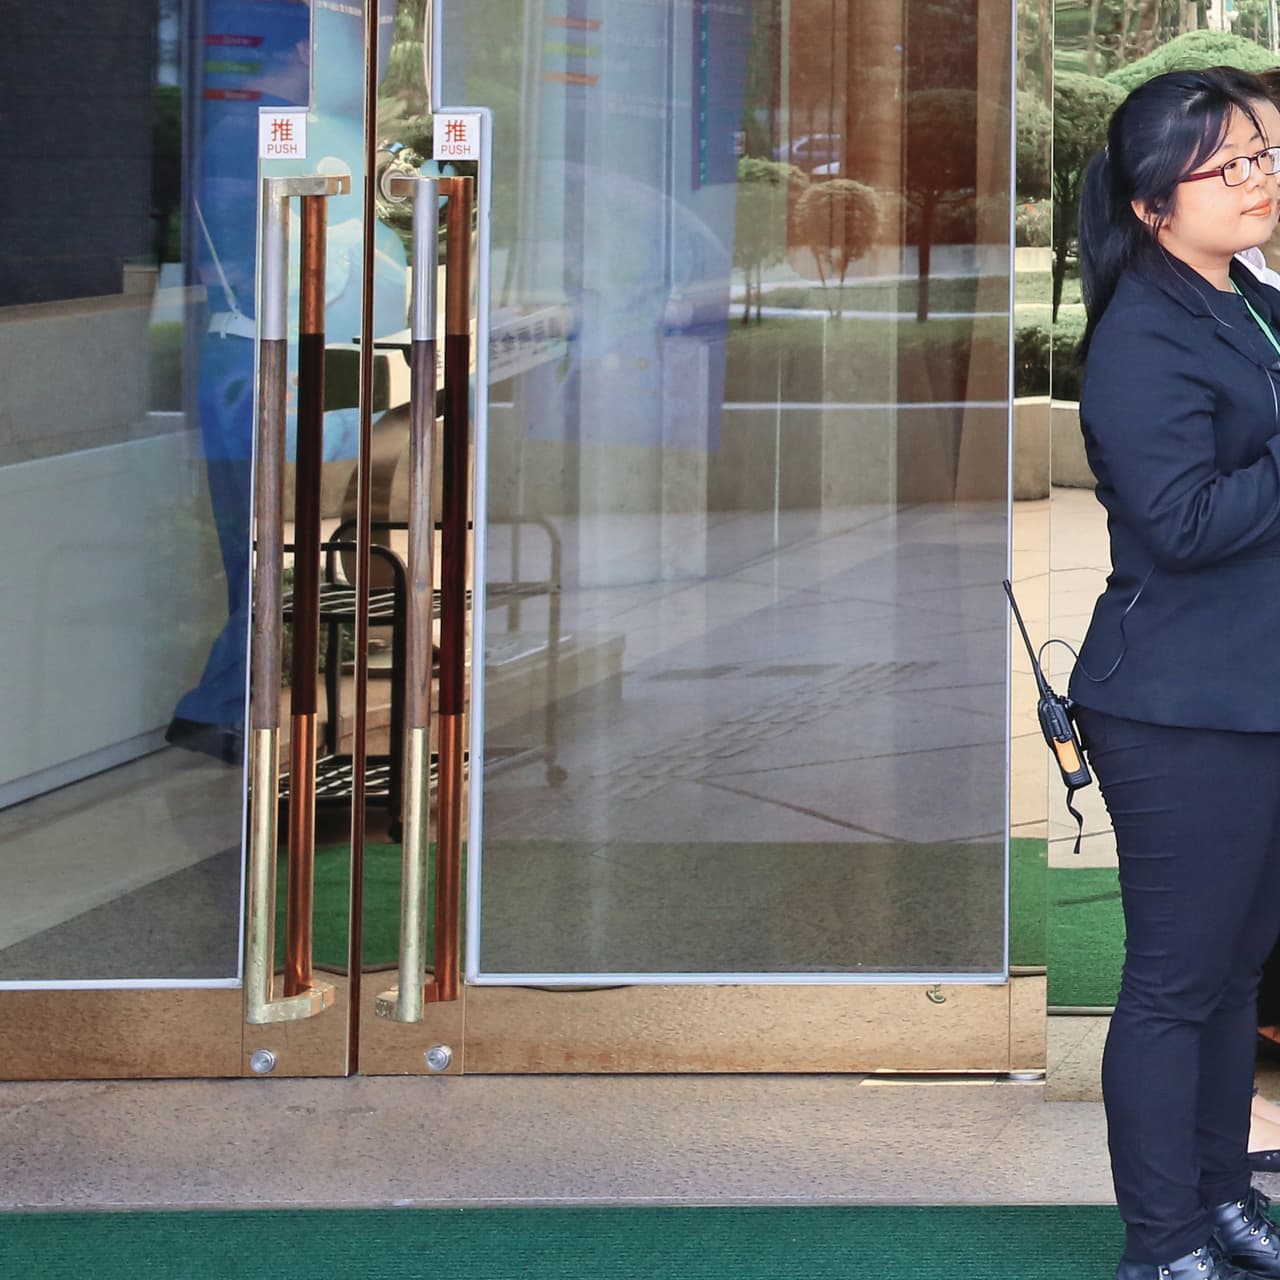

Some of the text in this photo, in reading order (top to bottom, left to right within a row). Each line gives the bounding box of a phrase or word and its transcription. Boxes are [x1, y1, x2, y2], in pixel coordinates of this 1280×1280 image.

[271, 119, 293, 142] 推
[445, 120, 467, 143] 推
[267, 144, 298, 154] PUSH
[440, 145, 471, 155] PUSH
